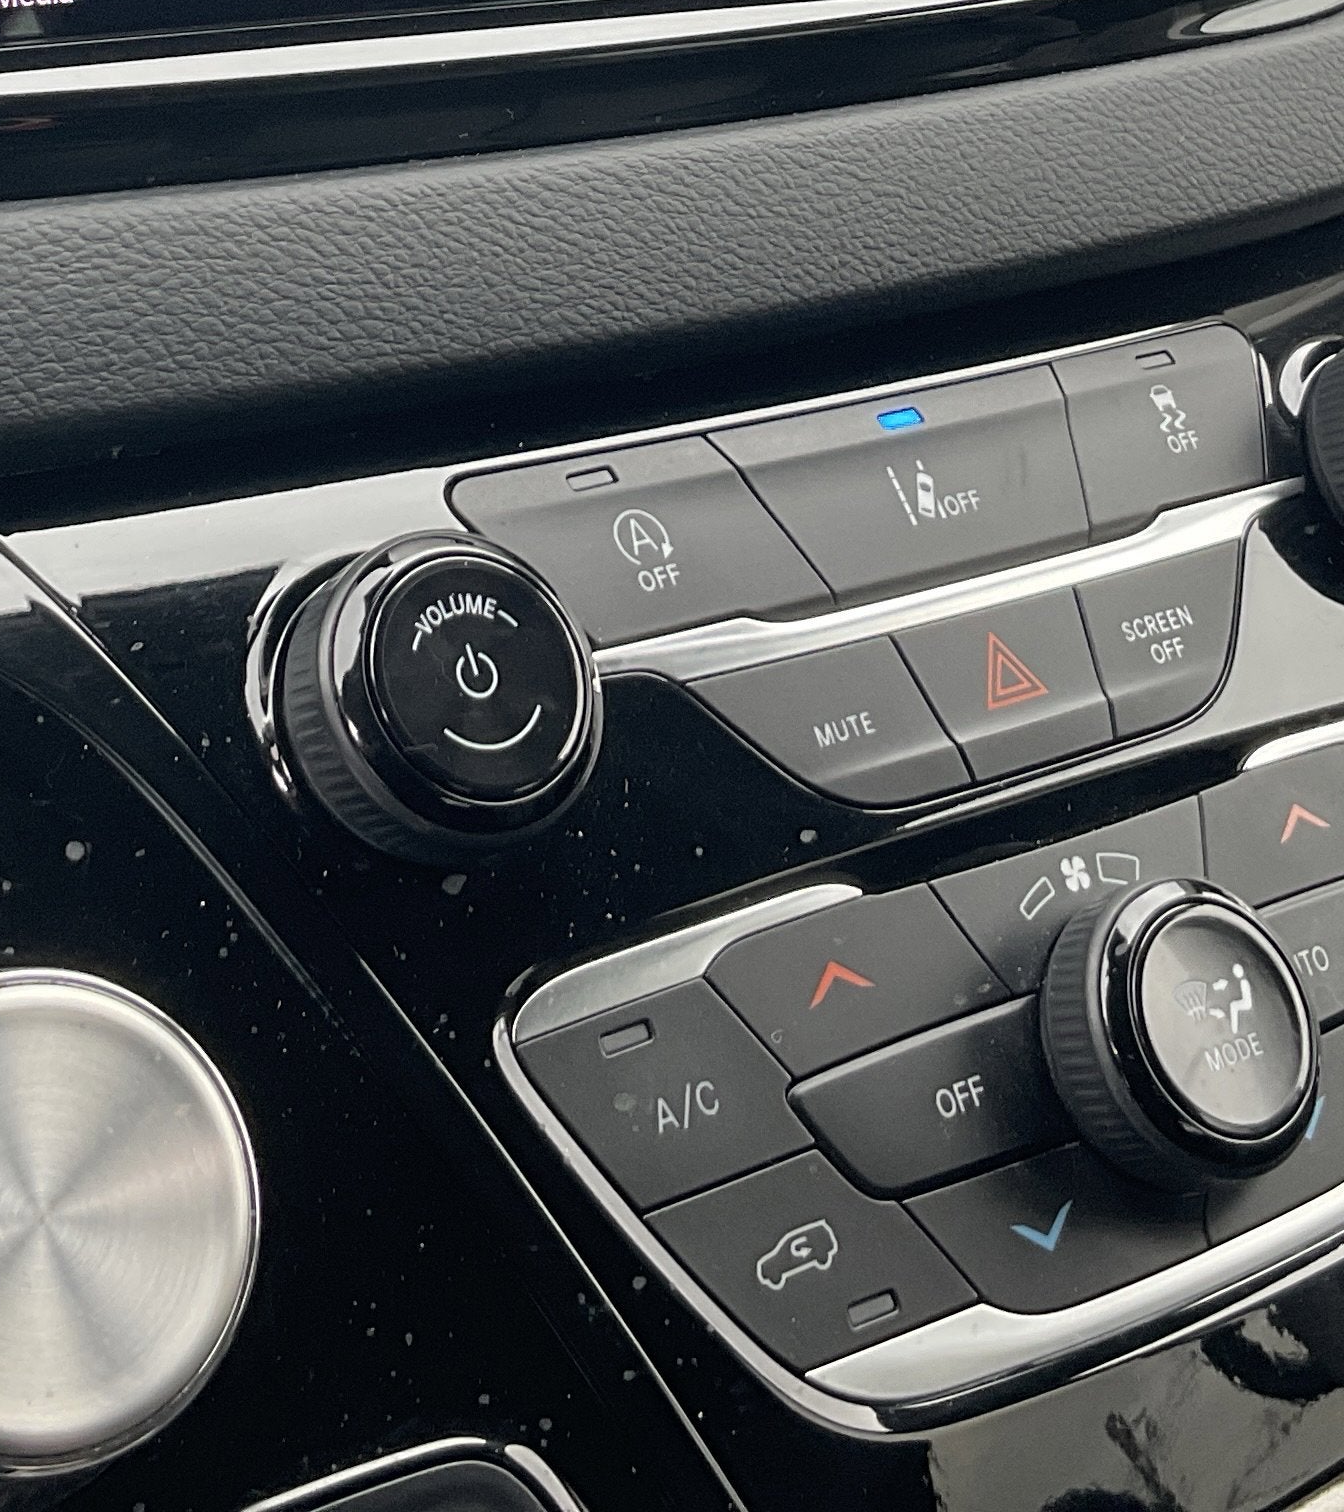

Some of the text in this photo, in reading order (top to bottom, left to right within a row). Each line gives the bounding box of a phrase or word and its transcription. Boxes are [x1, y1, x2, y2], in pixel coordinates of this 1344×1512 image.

[1164, 427, 1200, 454] OFF
[944, 489, 981, 514] OFF
[637, 562, 680, 592] OFF
[415, 592, 498, 636] VOLUME
[1121, 605, 1194, 643] SCREEN
[1150, 636, 1184, 664] OFF
[813, 711, 876, 748] MUTE
[1203, 1031, 1266, 1074] MODE
[657, 1080, 720, 1134] A/C
[935, 1075, 984, 1119] OFF
